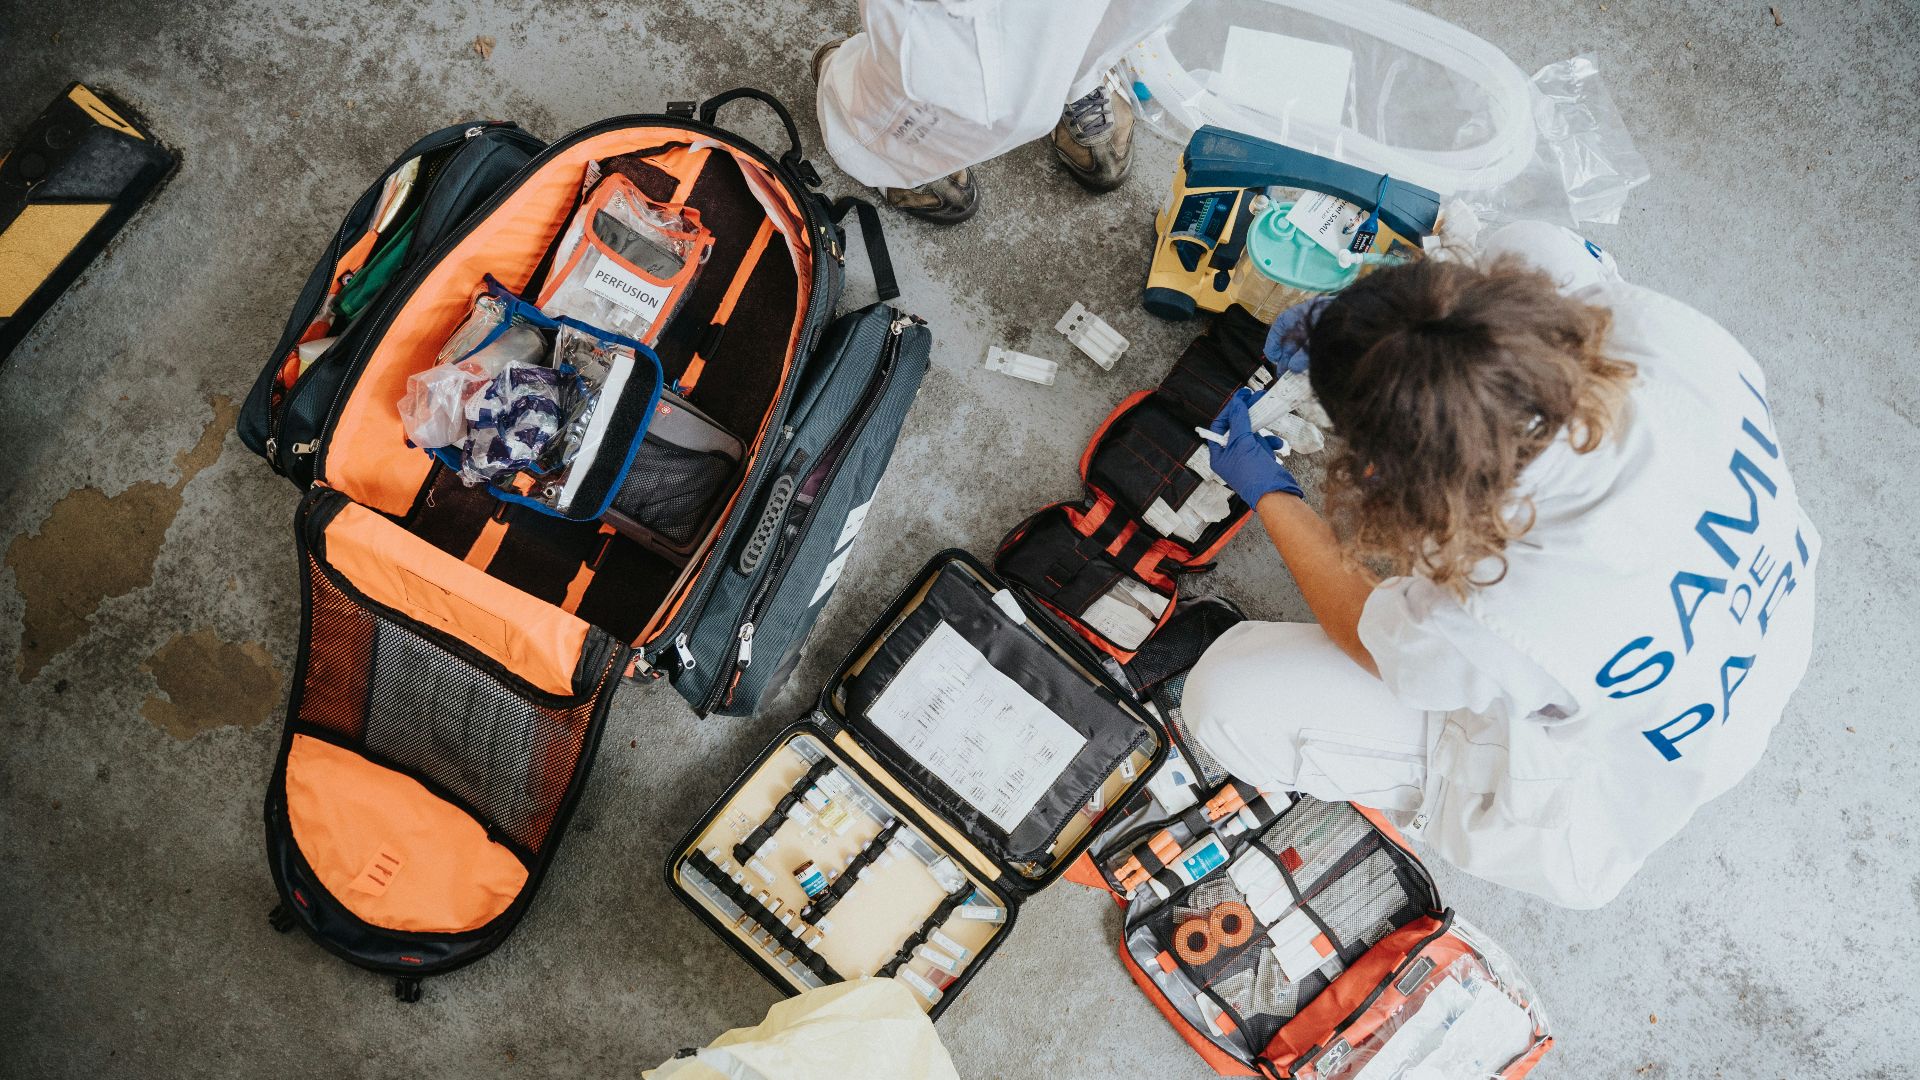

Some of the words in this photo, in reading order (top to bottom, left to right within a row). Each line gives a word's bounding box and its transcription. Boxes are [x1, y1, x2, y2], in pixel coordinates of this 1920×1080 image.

[1318, 212, 1338, 235] SAMU
[595, 269, 659, 309] PERFUSION
[1729, 545, 1776, 625] DE
[1642, 526, 1809, 761] PARI
